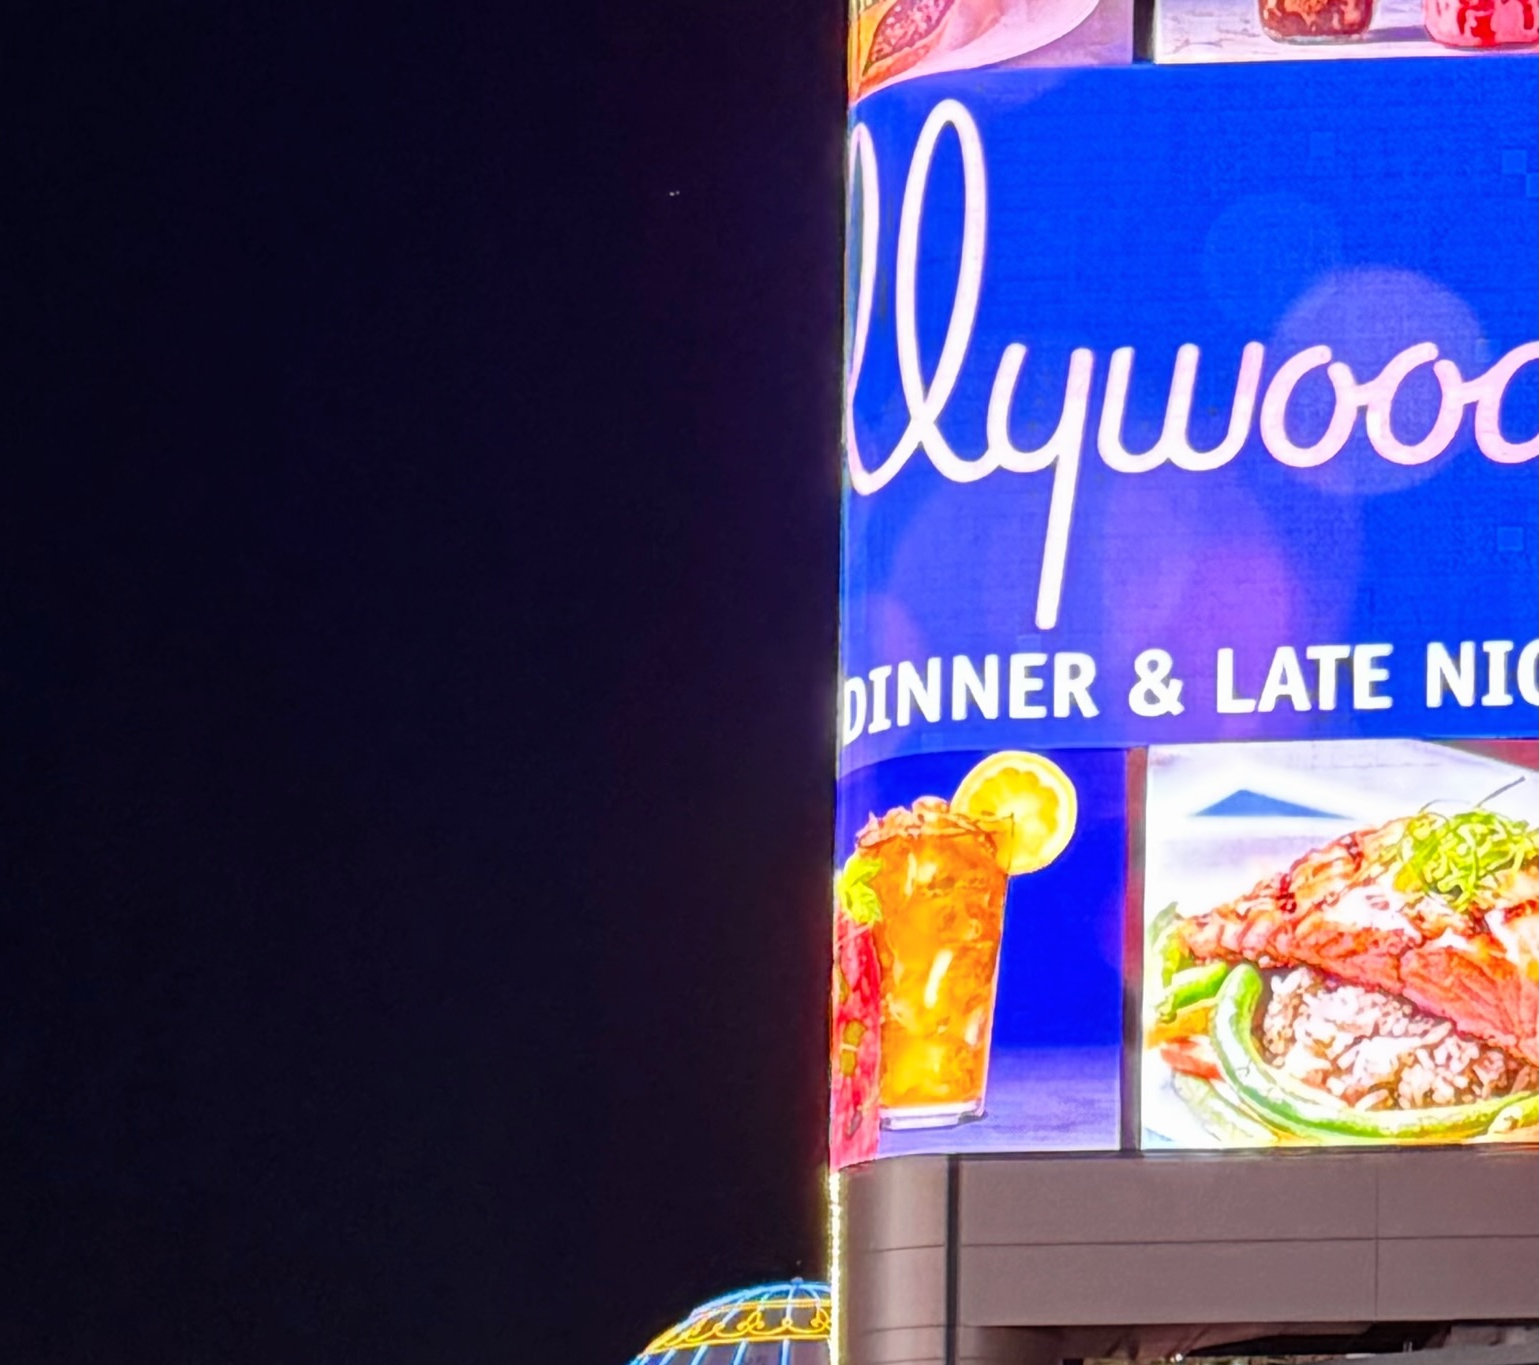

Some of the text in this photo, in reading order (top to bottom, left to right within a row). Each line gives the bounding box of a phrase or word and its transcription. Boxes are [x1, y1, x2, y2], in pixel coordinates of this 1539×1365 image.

[841, 652, 1100, 746] DINNER
[1127, 647, 1185, 717] &
[1215, 643, 1395, 714] LATE
